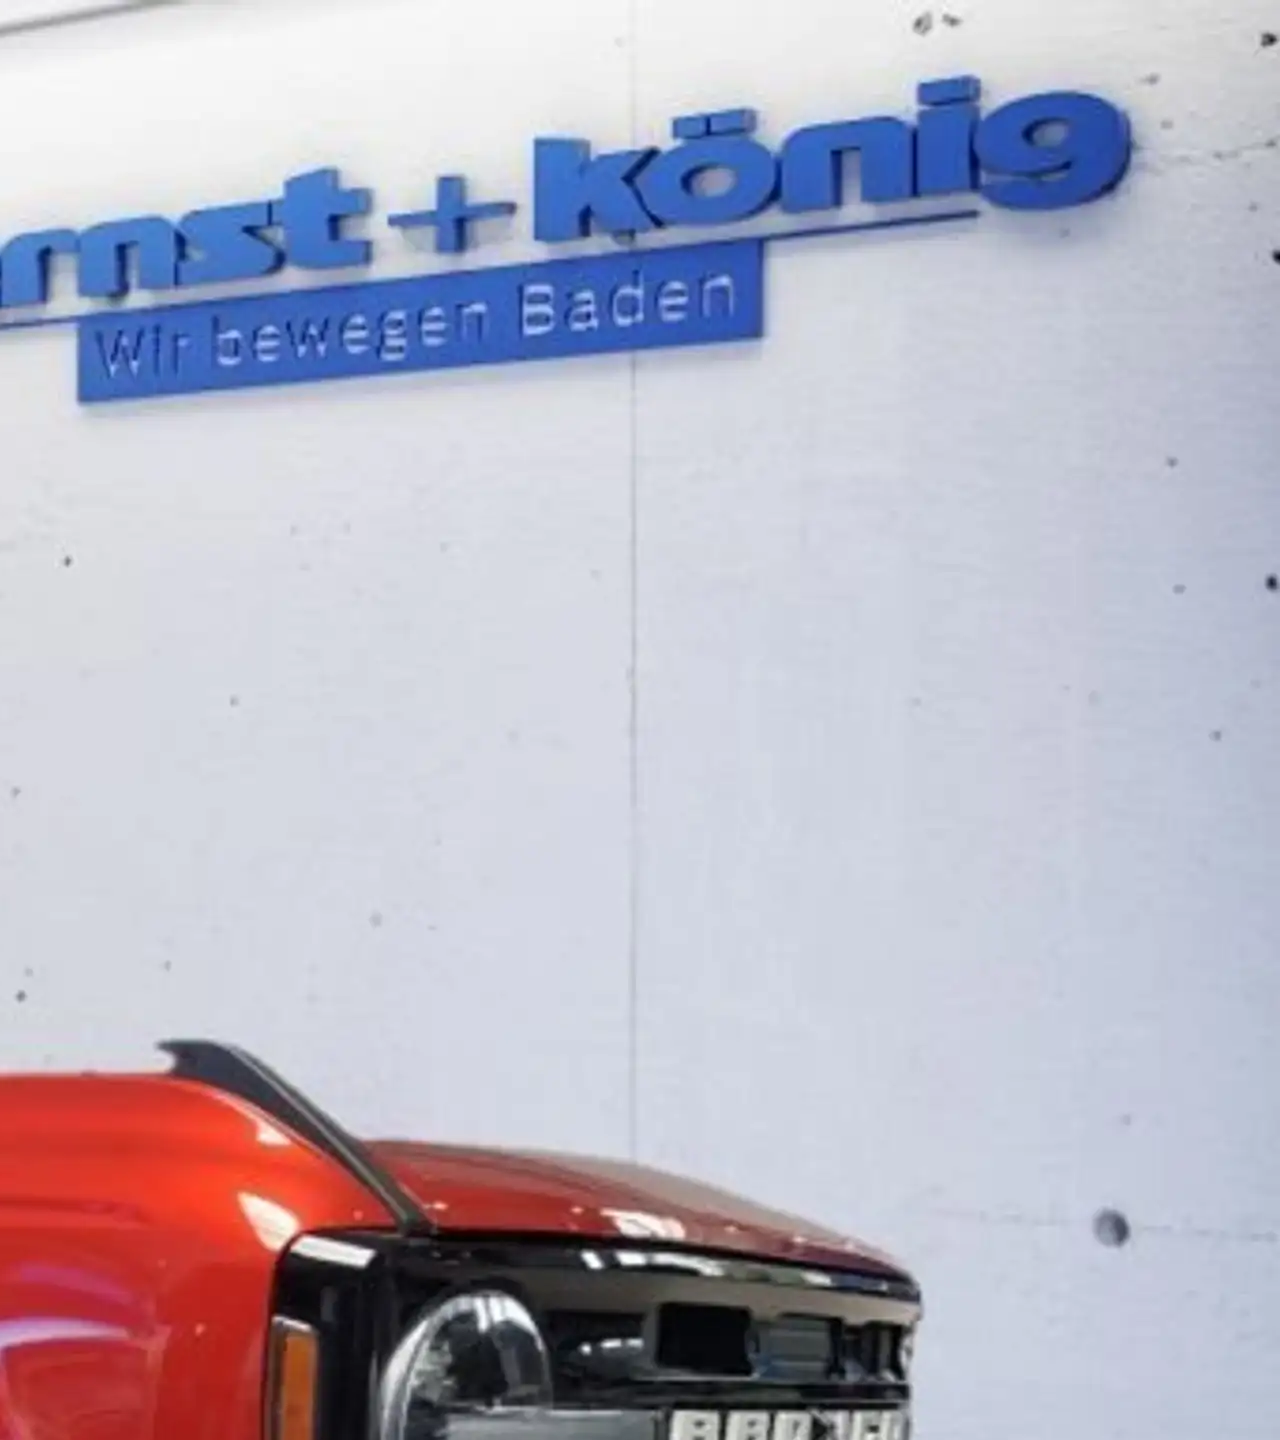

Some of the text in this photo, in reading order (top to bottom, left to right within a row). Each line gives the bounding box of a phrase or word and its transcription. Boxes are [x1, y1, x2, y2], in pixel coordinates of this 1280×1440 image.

[93, 269, 737, 380] Wir bewegen Baden
